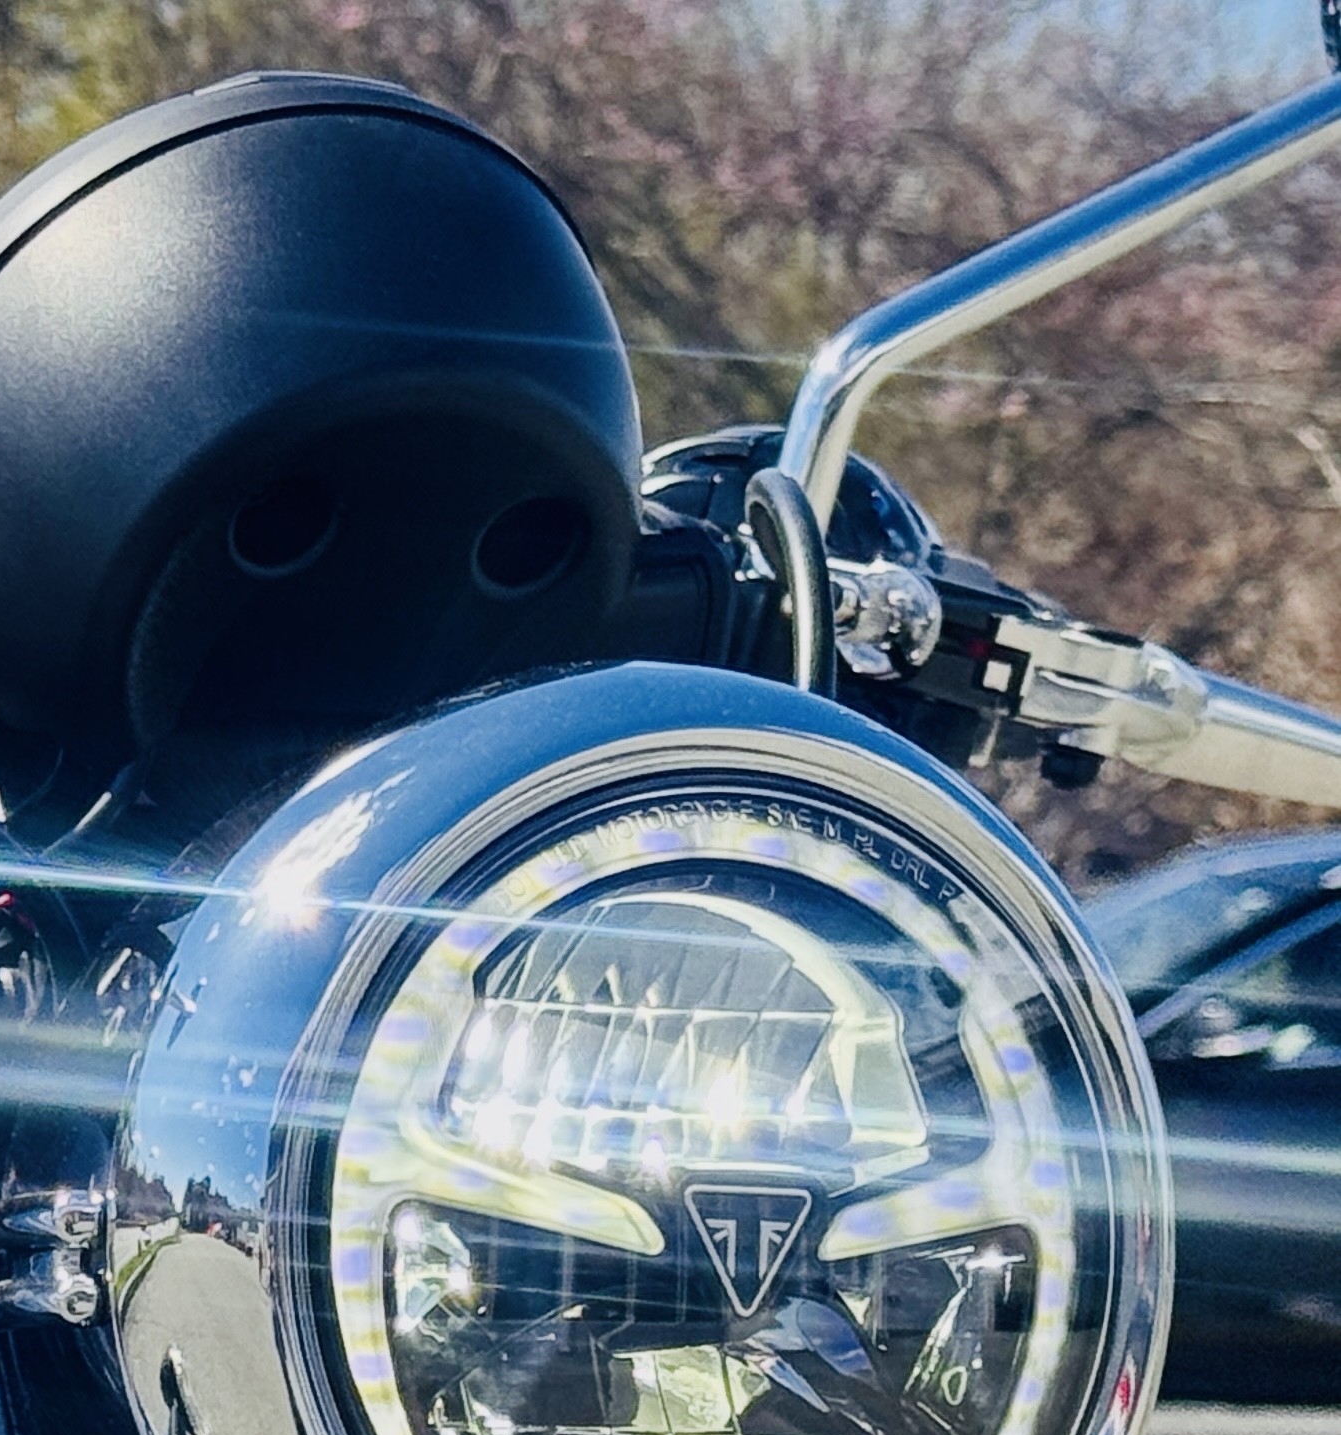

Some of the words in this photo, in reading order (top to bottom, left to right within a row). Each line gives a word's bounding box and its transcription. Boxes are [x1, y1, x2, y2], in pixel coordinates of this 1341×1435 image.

[595, 799, 758, 847] MOTORCYCLE
[767, 802, 813, 833] SAE
[823, 815, 842, 840] M
